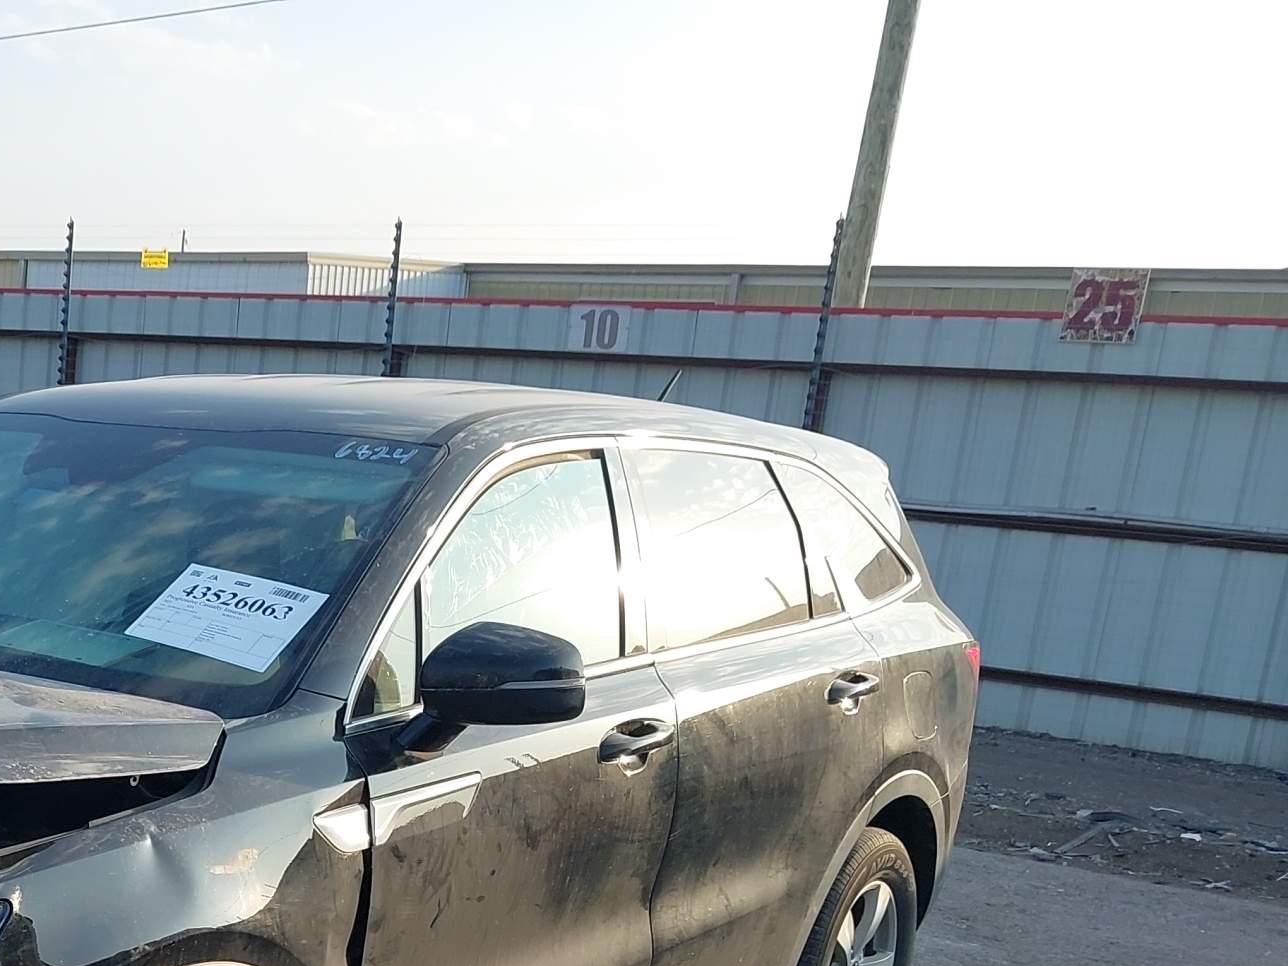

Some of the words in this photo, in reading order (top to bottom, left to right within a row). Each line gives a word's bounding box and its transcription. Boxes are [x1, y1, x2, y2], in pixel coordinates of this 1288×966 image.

[1065, 278, 1140, 332] 25
[580, 308, 620, 350] 10
[181, 583, 295, 621] 43526063
